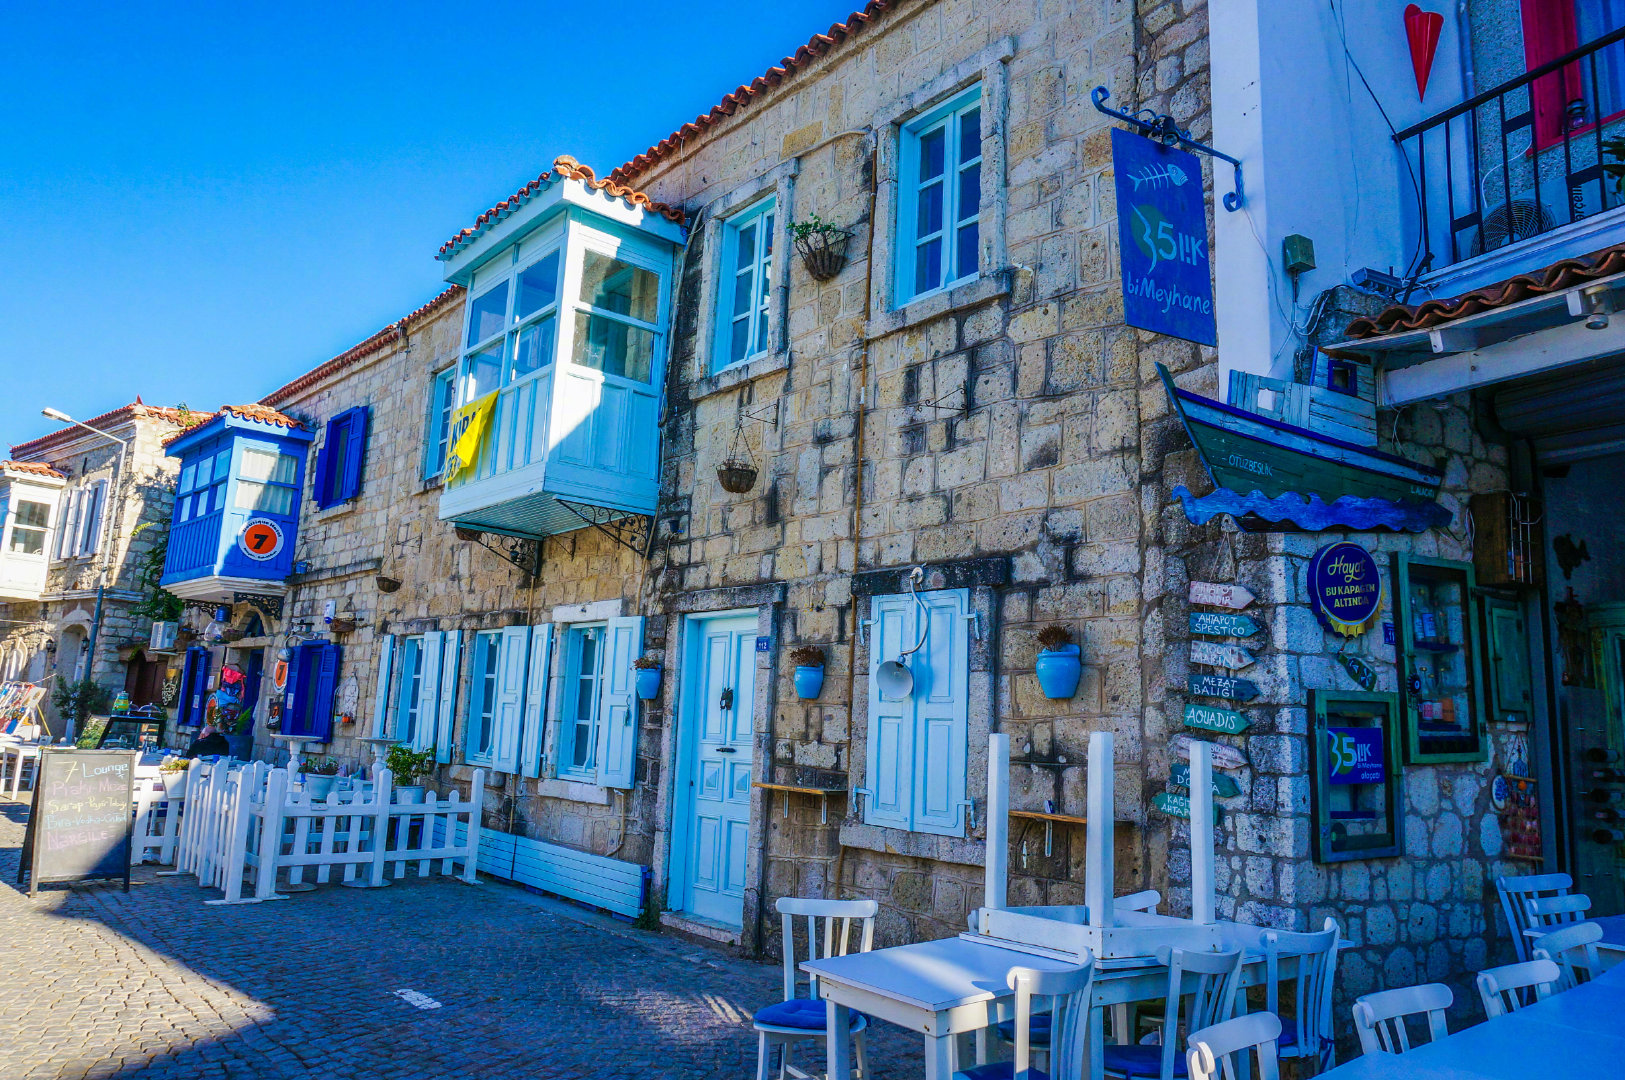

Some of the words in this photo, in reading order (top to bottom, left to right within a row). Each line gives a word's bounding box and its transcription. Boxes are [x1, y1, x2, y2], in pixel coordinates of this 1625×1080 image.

[253, 533, 269, 550] 7
[1198, 614, 1238, 626] AHTAPOT
[1202, 676, 1238, 689] MEZAT
[1193, 684, 1235, 697] BALIĞI
[55, 760, 79, 783] 7
[82, 762, 128, 779] Lounge
